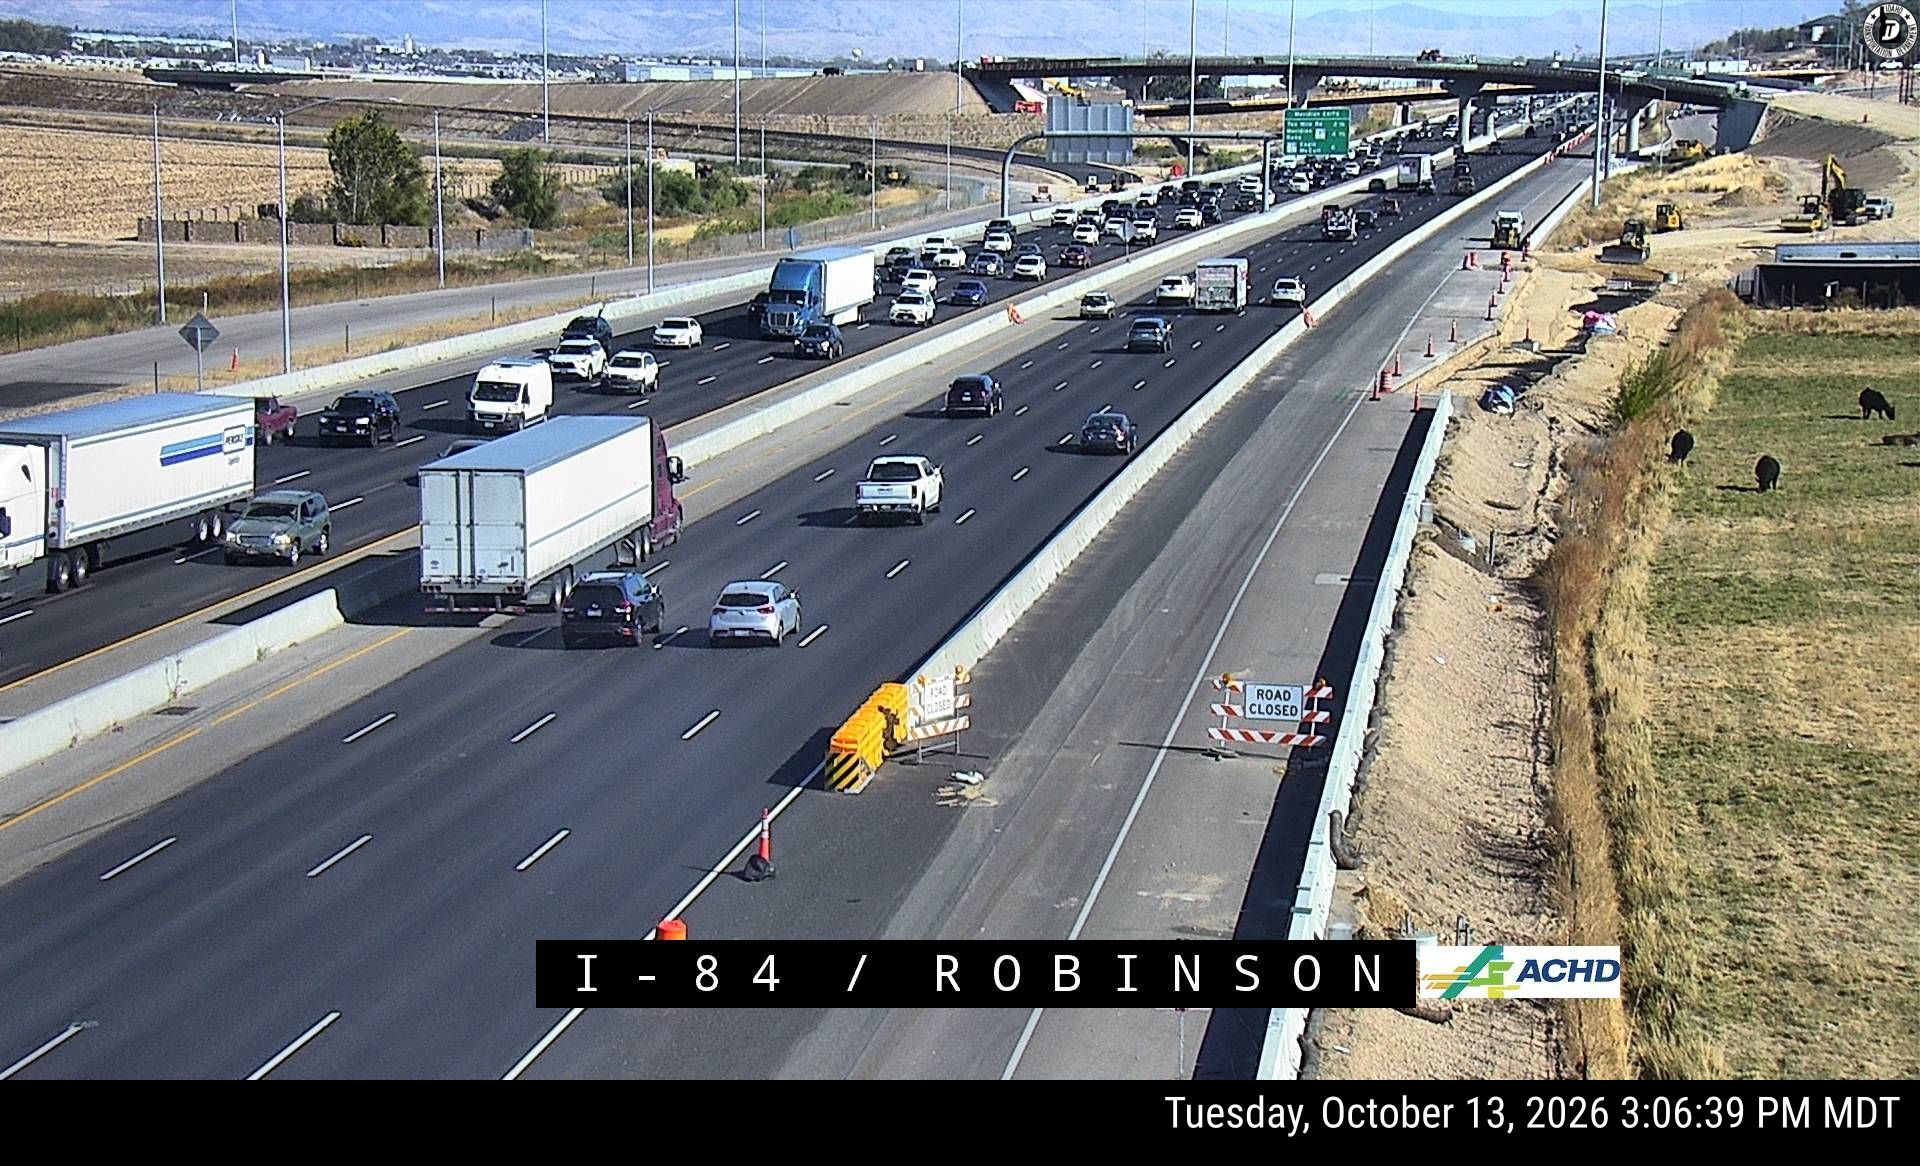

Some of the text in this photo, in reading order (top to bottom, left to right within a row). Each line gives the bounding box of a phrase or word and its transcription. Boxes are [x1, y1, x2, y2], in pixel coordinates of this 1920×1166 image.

[929, 685, 947, 698] ROAD
[1256, 689, 1292, 702] ROAD
[927, 699, 952, 715] CLOSED
[1249, 703, 1298, 717] CLOSED
